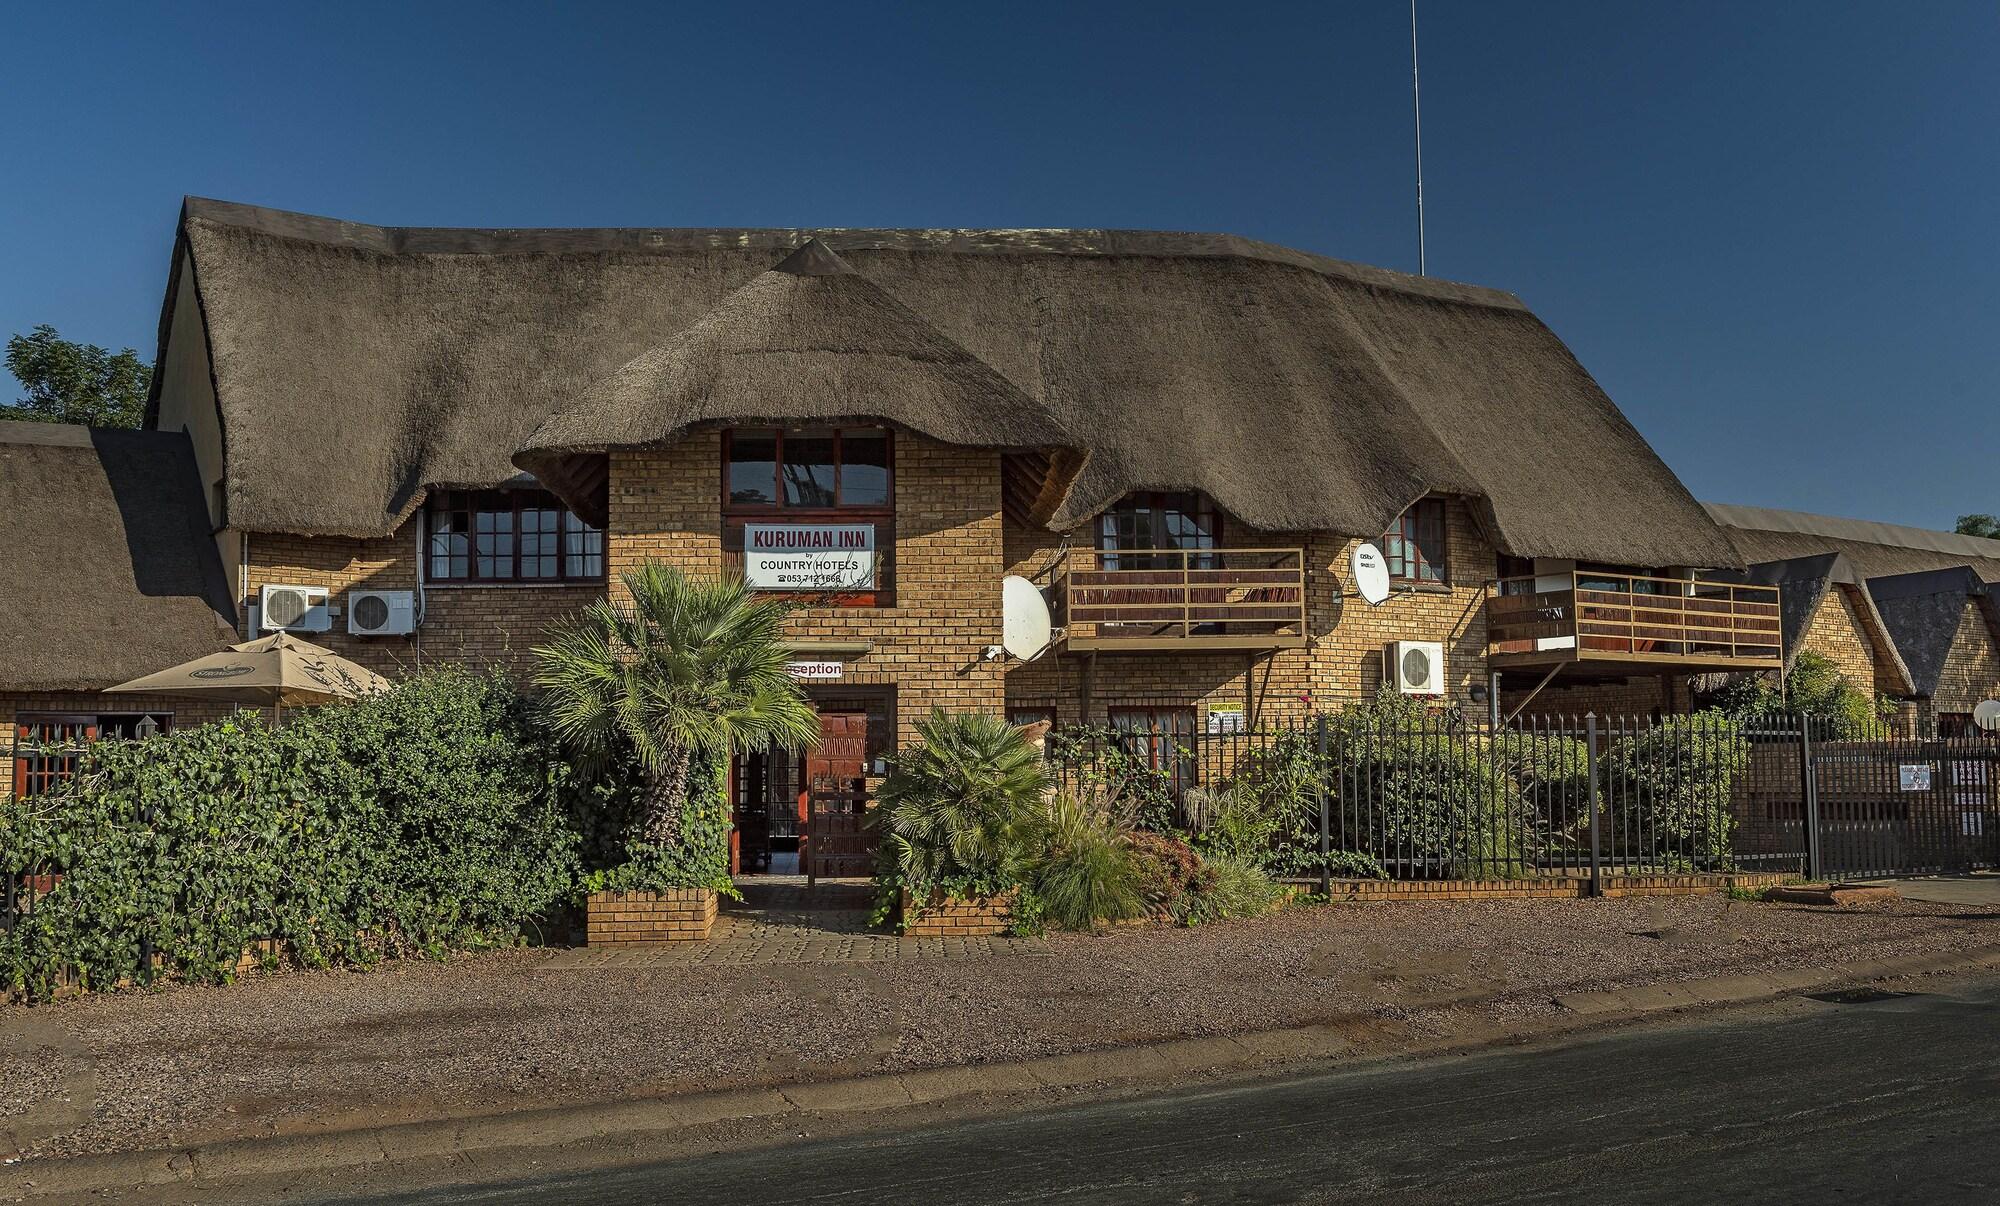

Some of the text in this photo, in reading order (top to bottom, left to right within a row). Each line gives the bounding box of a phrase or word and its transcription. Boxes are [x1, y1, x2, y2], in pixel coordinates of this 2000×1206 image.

[754, 531, 865, 547] KURUMAN INN
[760, 561, 858, 570] COUNTRY HOTELS
[787, 574, 801, 582] 053
[786, 663, 841, 676] eception
